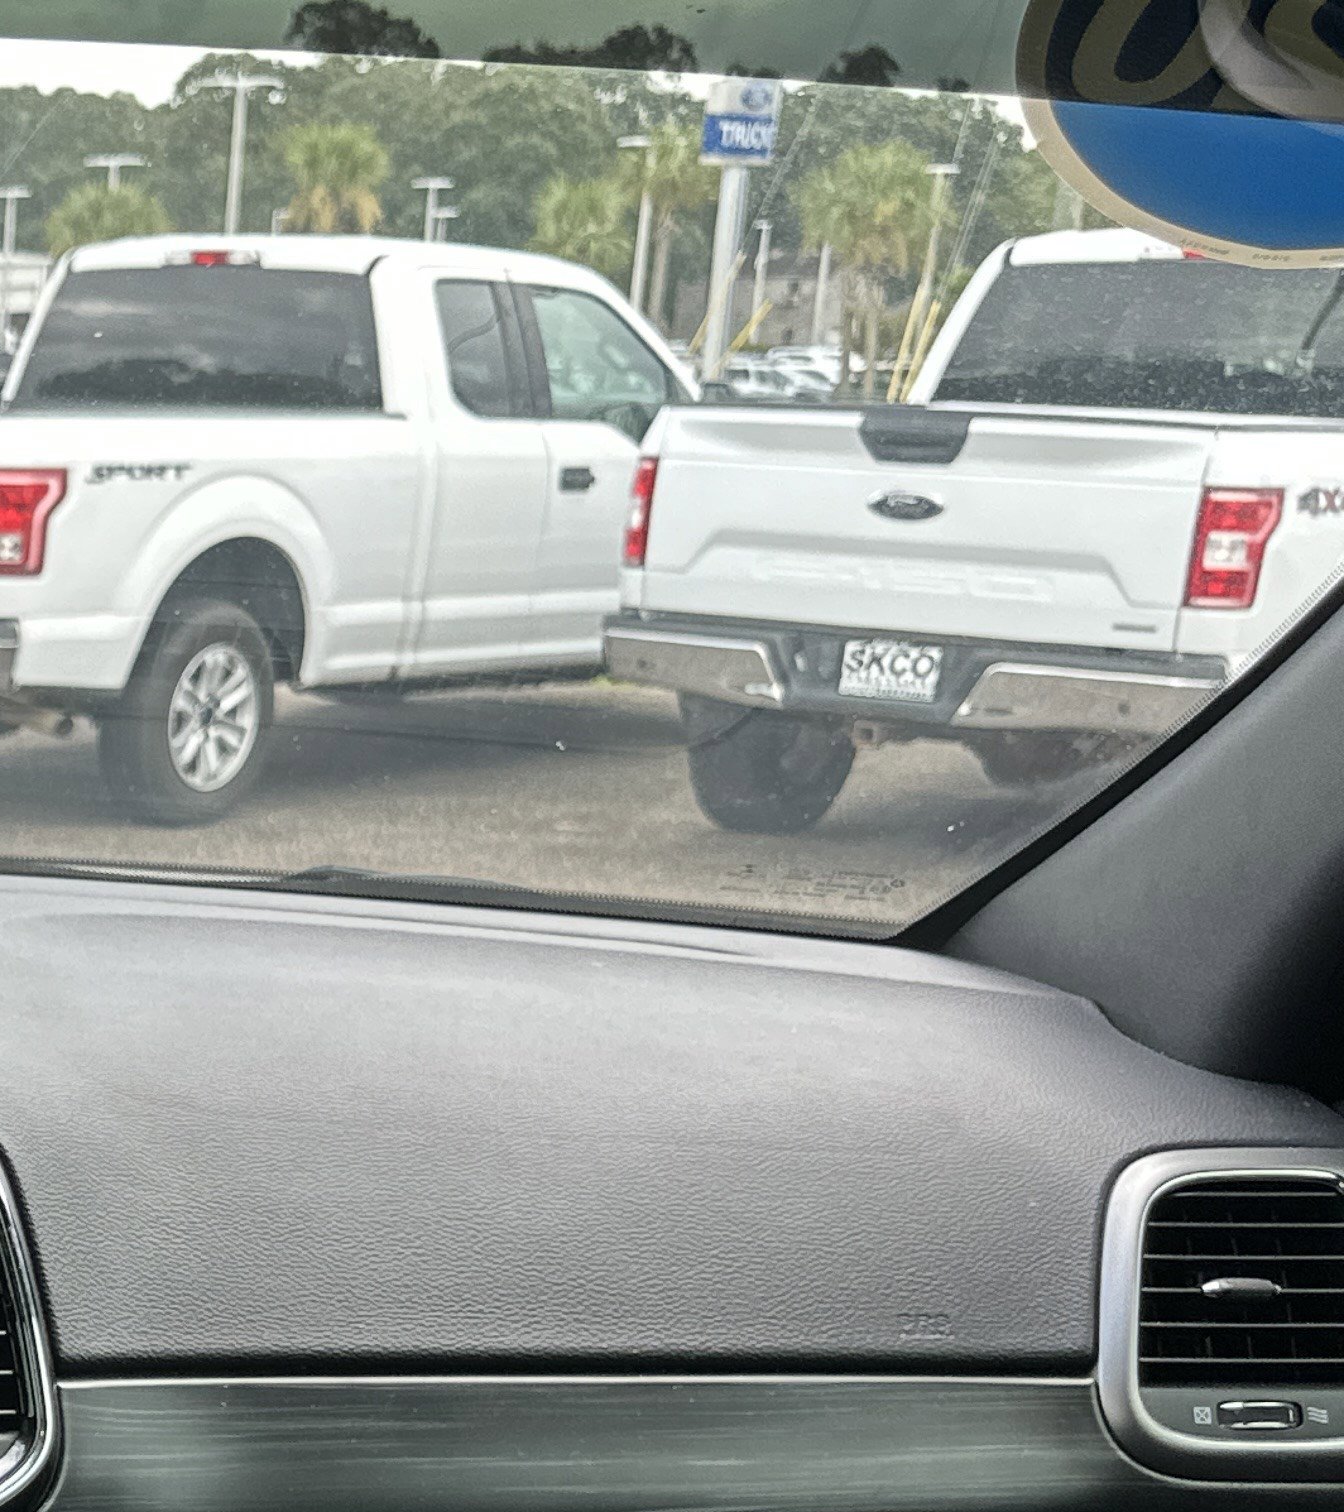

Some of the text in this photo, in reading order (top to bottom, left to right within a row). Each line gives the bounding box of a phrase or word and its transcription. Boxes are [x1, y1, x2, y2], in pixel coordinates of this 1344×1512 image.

[84, 461, 192, 484] SPORT
[1297, 487, 1344, 516] 4X
[845, 649, 936, 678] SKCO
